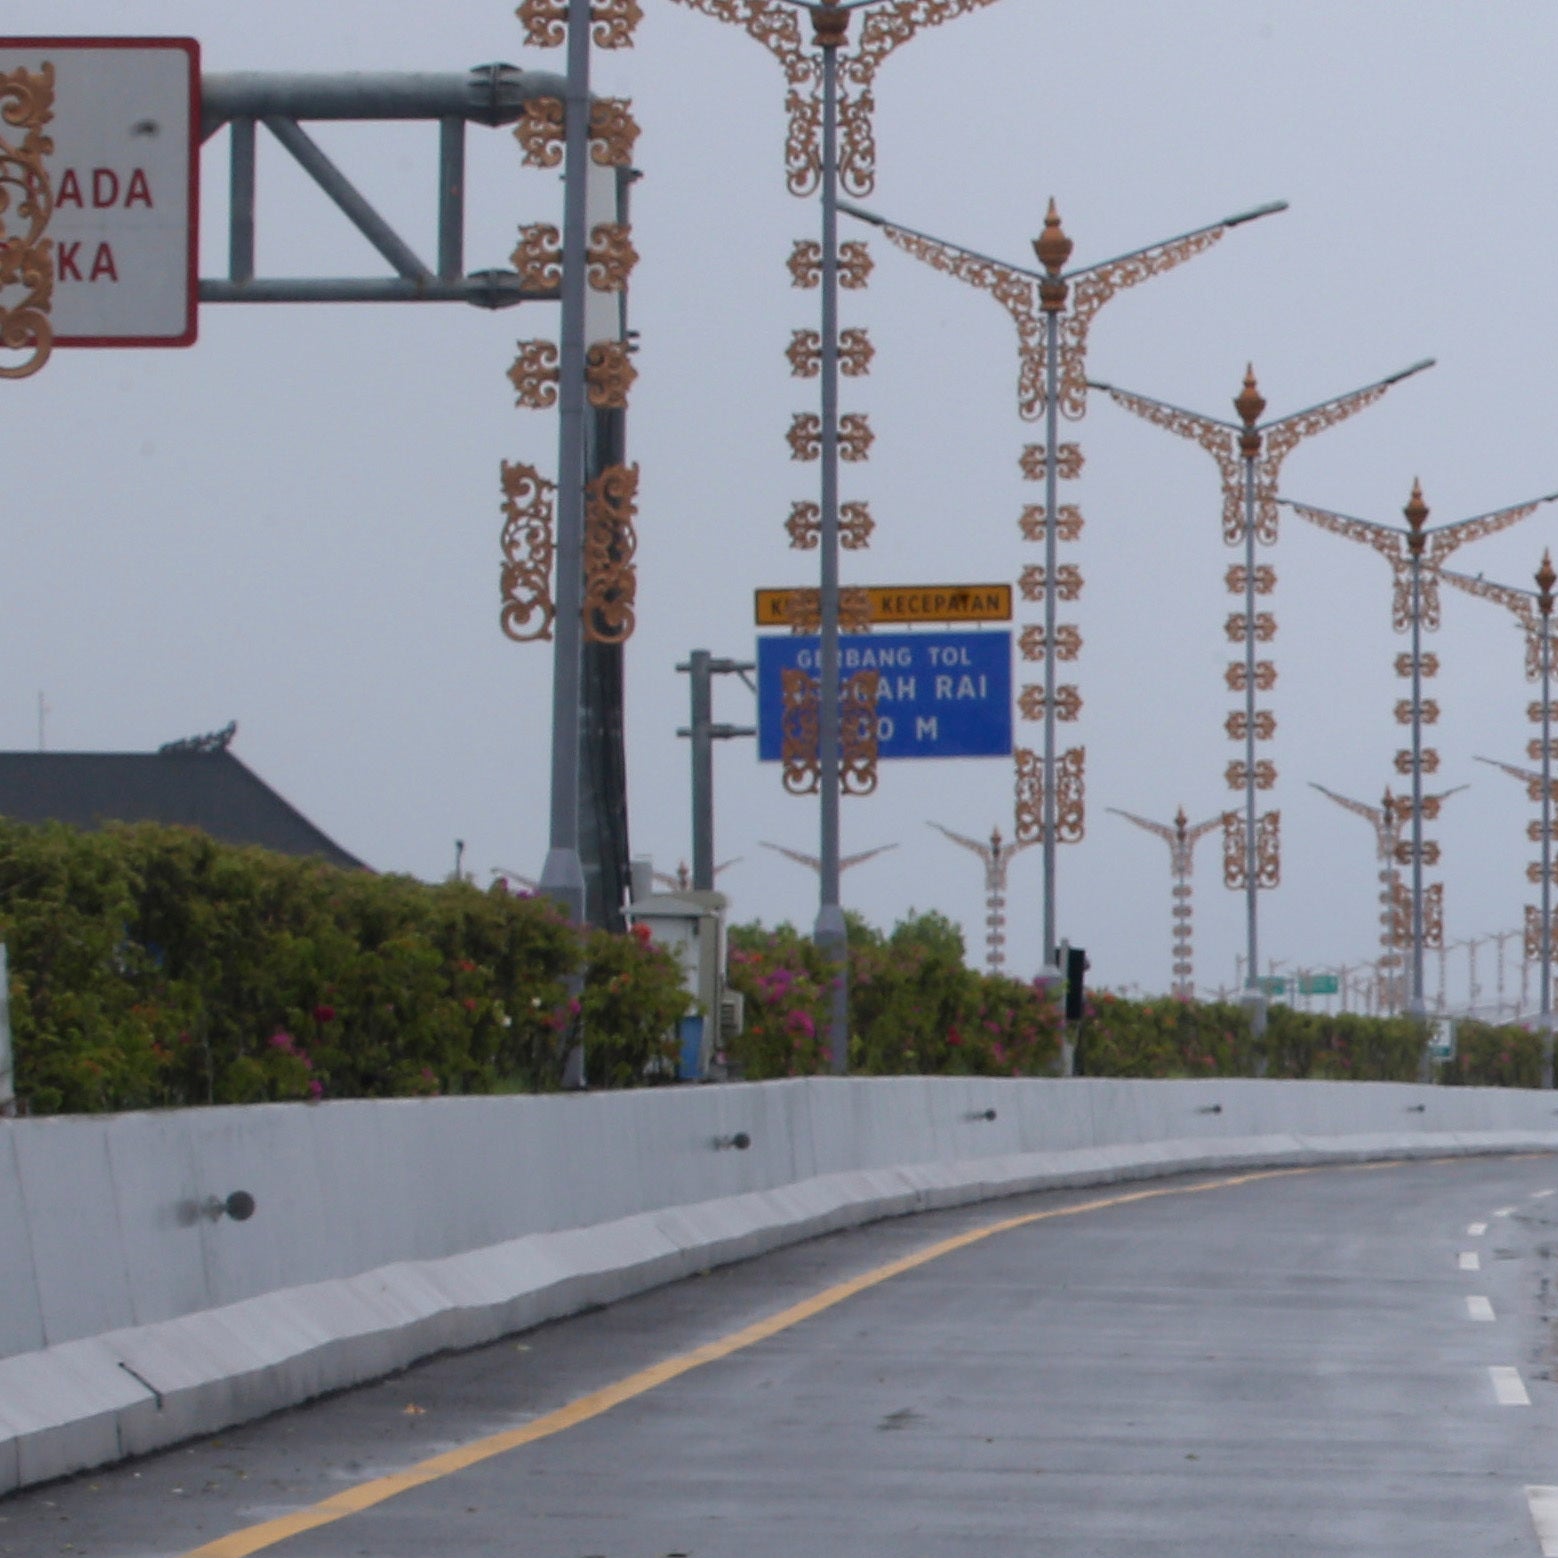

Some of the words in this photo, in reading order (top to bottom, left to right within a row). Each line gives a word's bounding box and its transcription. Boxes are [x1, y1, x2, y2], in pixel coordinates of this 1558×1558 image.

[881, 592, 1000, 615] KECEPATAN
[928, 646, 972, 666] TOL
[936, 674, 989, 701] RAI
[915, 714, 939, 741] M
